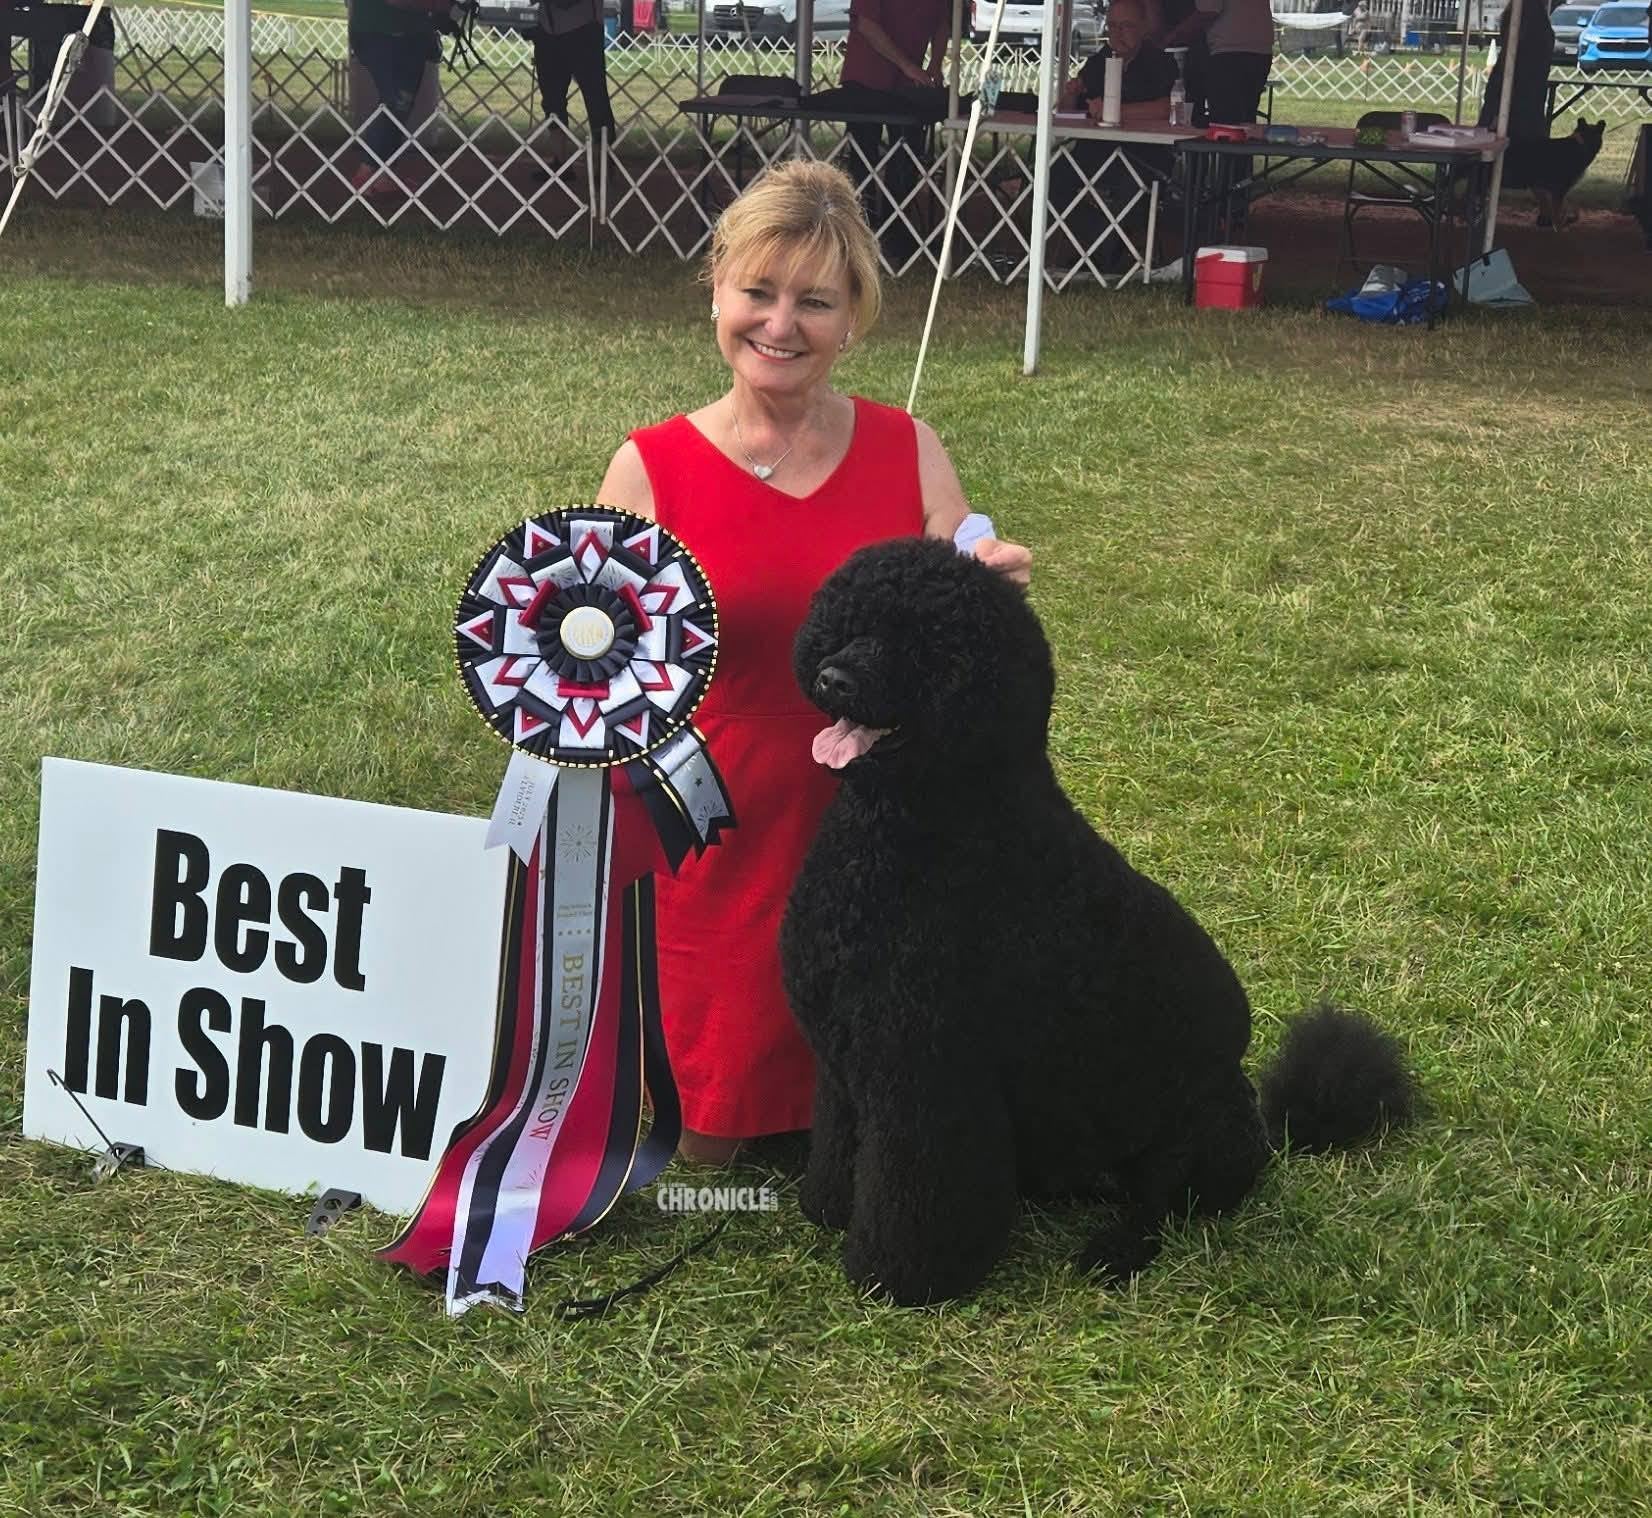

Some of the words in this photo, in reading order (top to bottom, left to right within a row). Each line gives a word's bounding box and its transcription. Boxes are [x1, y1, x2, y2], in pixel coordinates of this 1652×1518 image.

[150, 828, 371, 992] Best
[560, 953, 584, 1031] BEST
[64, 966, 151, 1106] In
[175, 987, 446, 1161] Show
[554, 1039, 577, 1070] IN
[530, 1077, 569, 1140] SHOW
